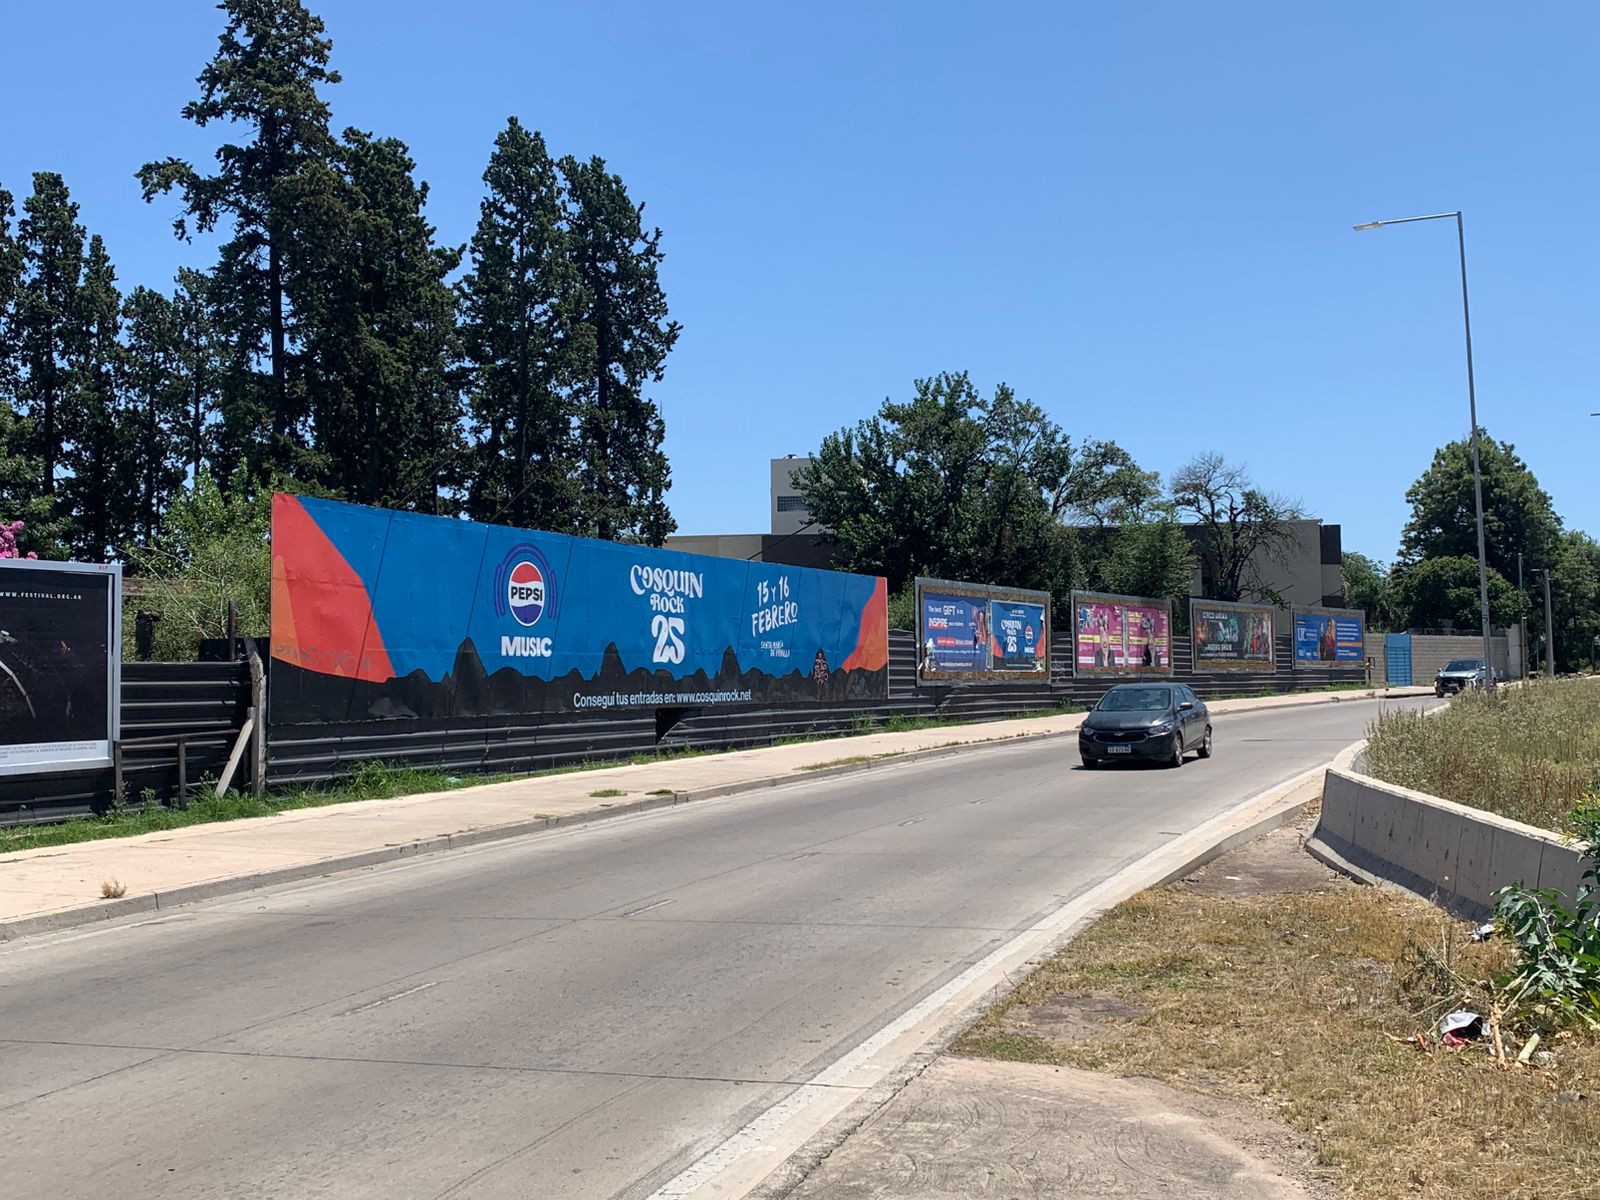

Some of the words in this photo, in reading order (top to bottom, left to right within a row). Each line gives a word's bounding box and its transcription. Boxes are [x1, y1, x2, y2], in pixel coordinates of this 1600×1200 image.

[510, 586, 543, 602] PEPSI
[630, 564, 703, 599] COSQUIN
[757, 580, 769, 607] 15
[779, 576, 790, 601] 16
[650, 593, 685, 613] ROCK
[751, 601, 798, 638] FEBRERO
[501, 635, 553, 657] MUSIC
[651, 614, 686, 665] 25
[616, 691, 629, 705] tus
[629, 690, 664, 705] entradas
[664, 692, 676, 704] en:
[676, 688, 752, 705] www.cosquinrock.net
